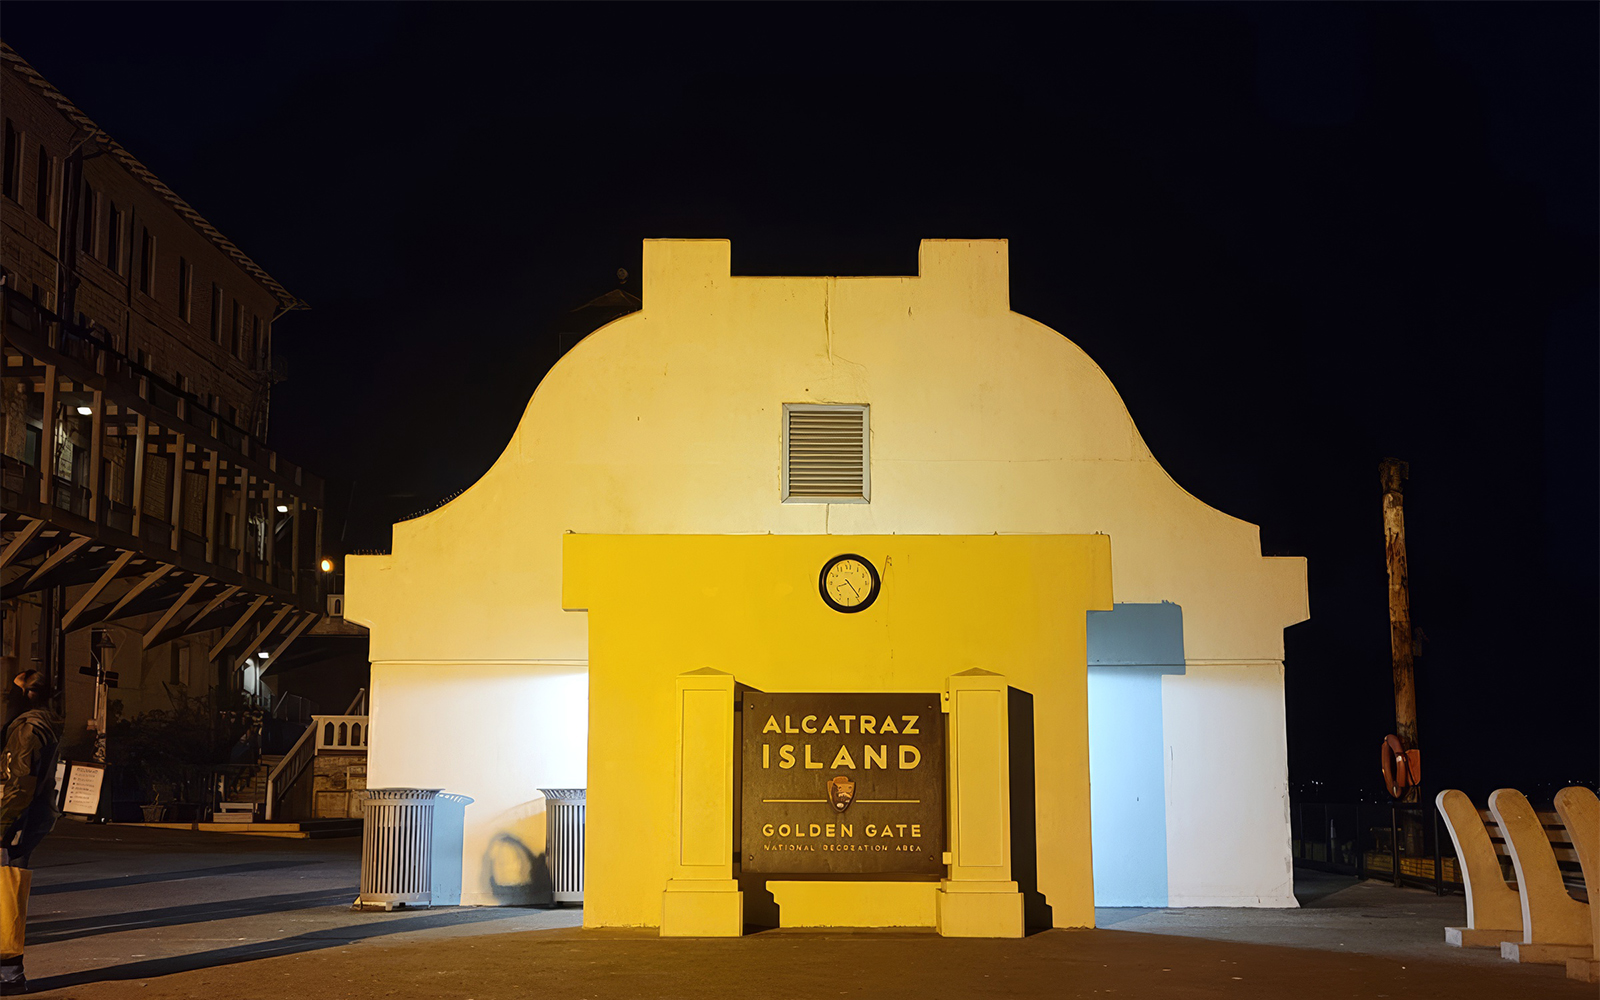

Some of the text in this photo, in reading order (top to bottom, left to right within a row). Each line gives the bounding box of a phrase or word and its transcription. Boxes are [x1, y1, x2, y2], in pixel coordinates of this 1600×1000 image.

[762, 715, 920, 734] ALCATRAZ
[762, 744, 921, 770] ISLAND
[762, 823, 922, 838] GOLDEN GATE
[763, 844, 815, 852] NATIONAL
